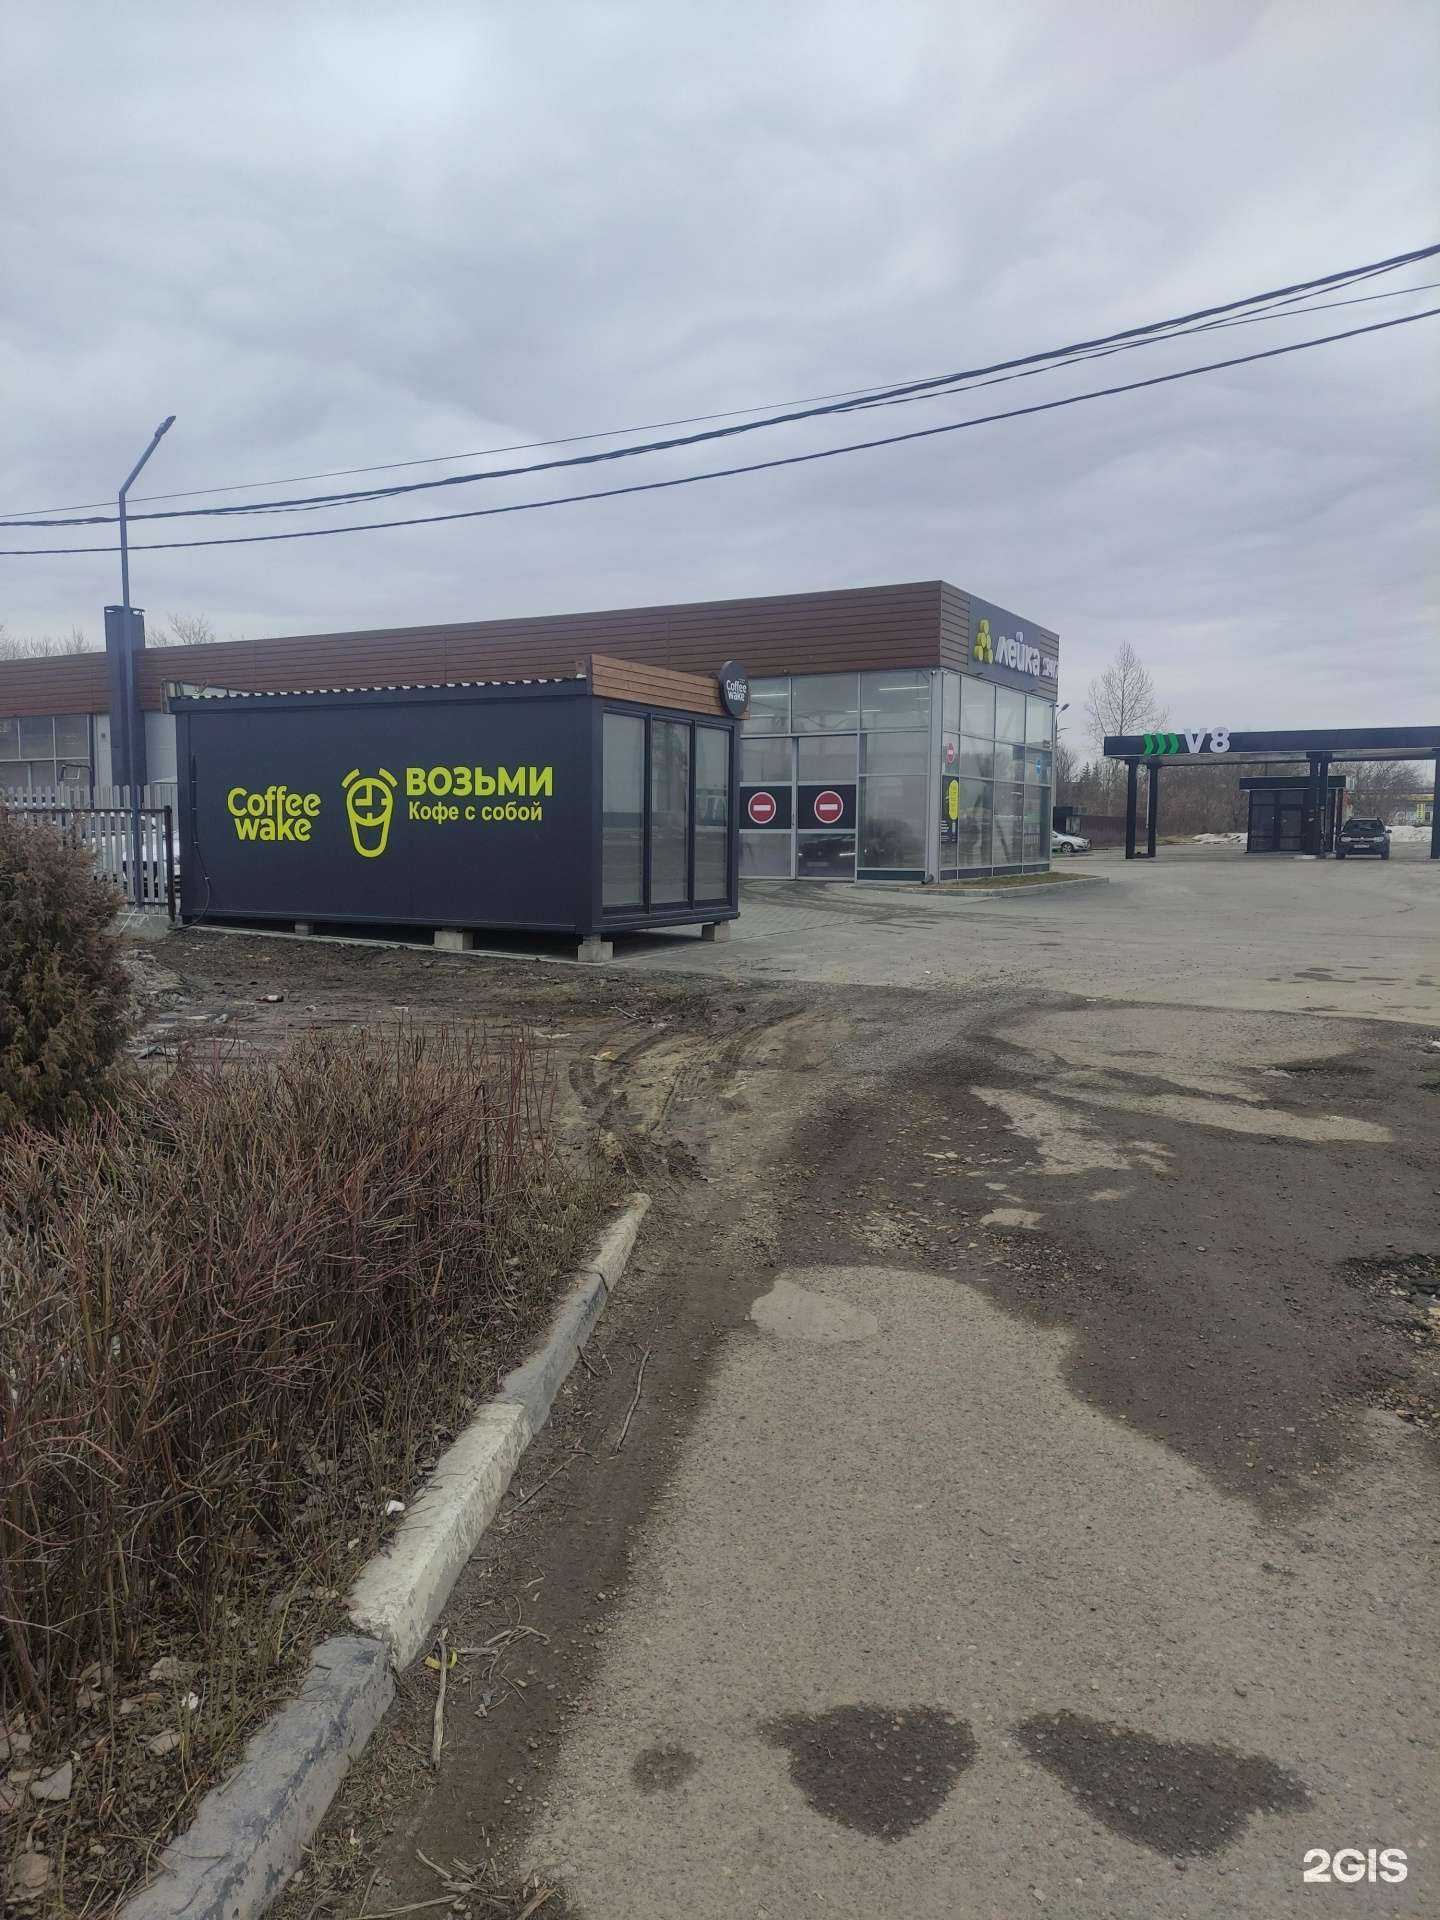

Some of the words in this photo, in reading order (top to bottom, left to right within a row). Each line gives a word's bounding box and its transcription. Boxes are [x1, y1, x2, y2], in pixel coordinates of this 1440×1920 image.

[726, 679, 747, 693] Coffee
[1183, 727, 1231, 753] V8
[406, 766, 553, 797] ВОЗЬМИ
[227, 786, 321, 818] Coffee
[408, 801, 459, 824] Кофе
[464, 804, 476, 820] с
[481, 801, 543, 821] собой
[234, 816, 312, 841] wake
